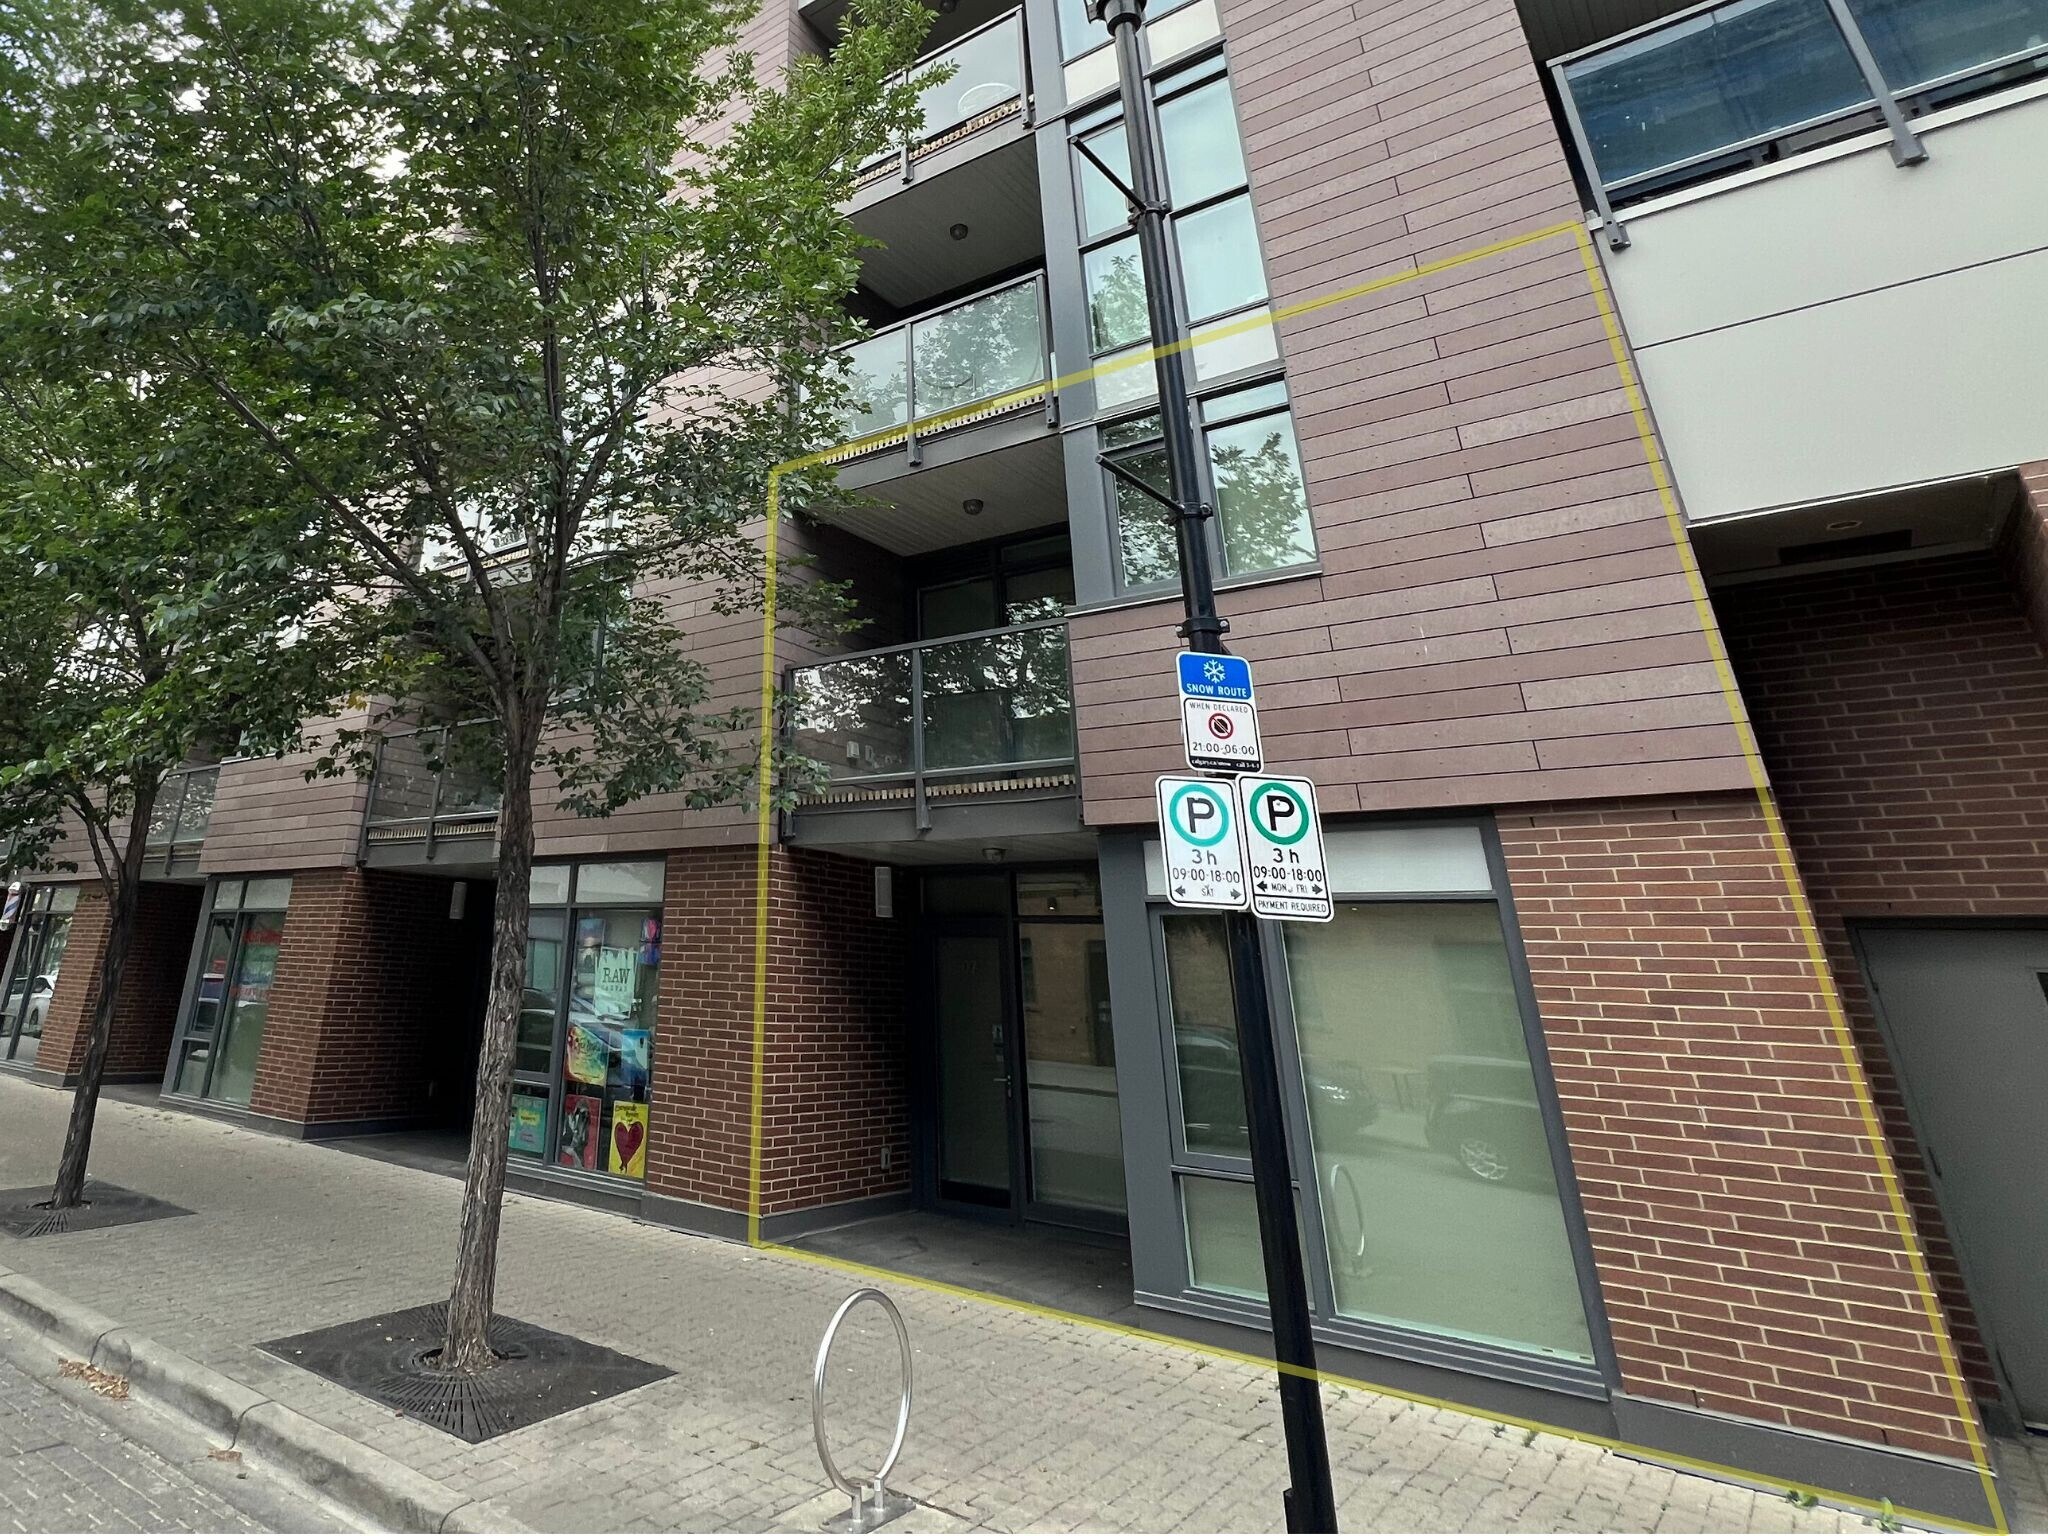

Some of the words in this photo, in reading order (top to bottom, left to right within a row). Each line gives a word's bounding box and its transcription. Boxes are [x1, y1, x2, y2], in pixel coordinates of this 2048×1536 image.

[1186, 683, 1214, 695] SNOW
[1217, 685, 1247, 698] ROUTE
[1190, 701, 1211, 711] WHEN
[1213, 703, 1248, 713] DECLARED
[1187, 797, 1215, 833] P
[1266, 795, 1295, 832] P
[1192, 849, 1202, 864] 3
[1206, 850, 1217, 865] h
[1273, 848, 1283, 863] 3
[1290, 849, 1300, 864] h
[1172, 867, 1240, 884] 09:00-18:00
[1253, 865, 1322, 882] 09:00-18:00
[1271, 883, 1287, 892] MON
[1296, 883, 1308, 893] FRI
[1258, 899, 1288, 910] PAYMENT
[1291, 901, 1327, 913] REQUIRED
[602, 967, 630, 984] RAW
